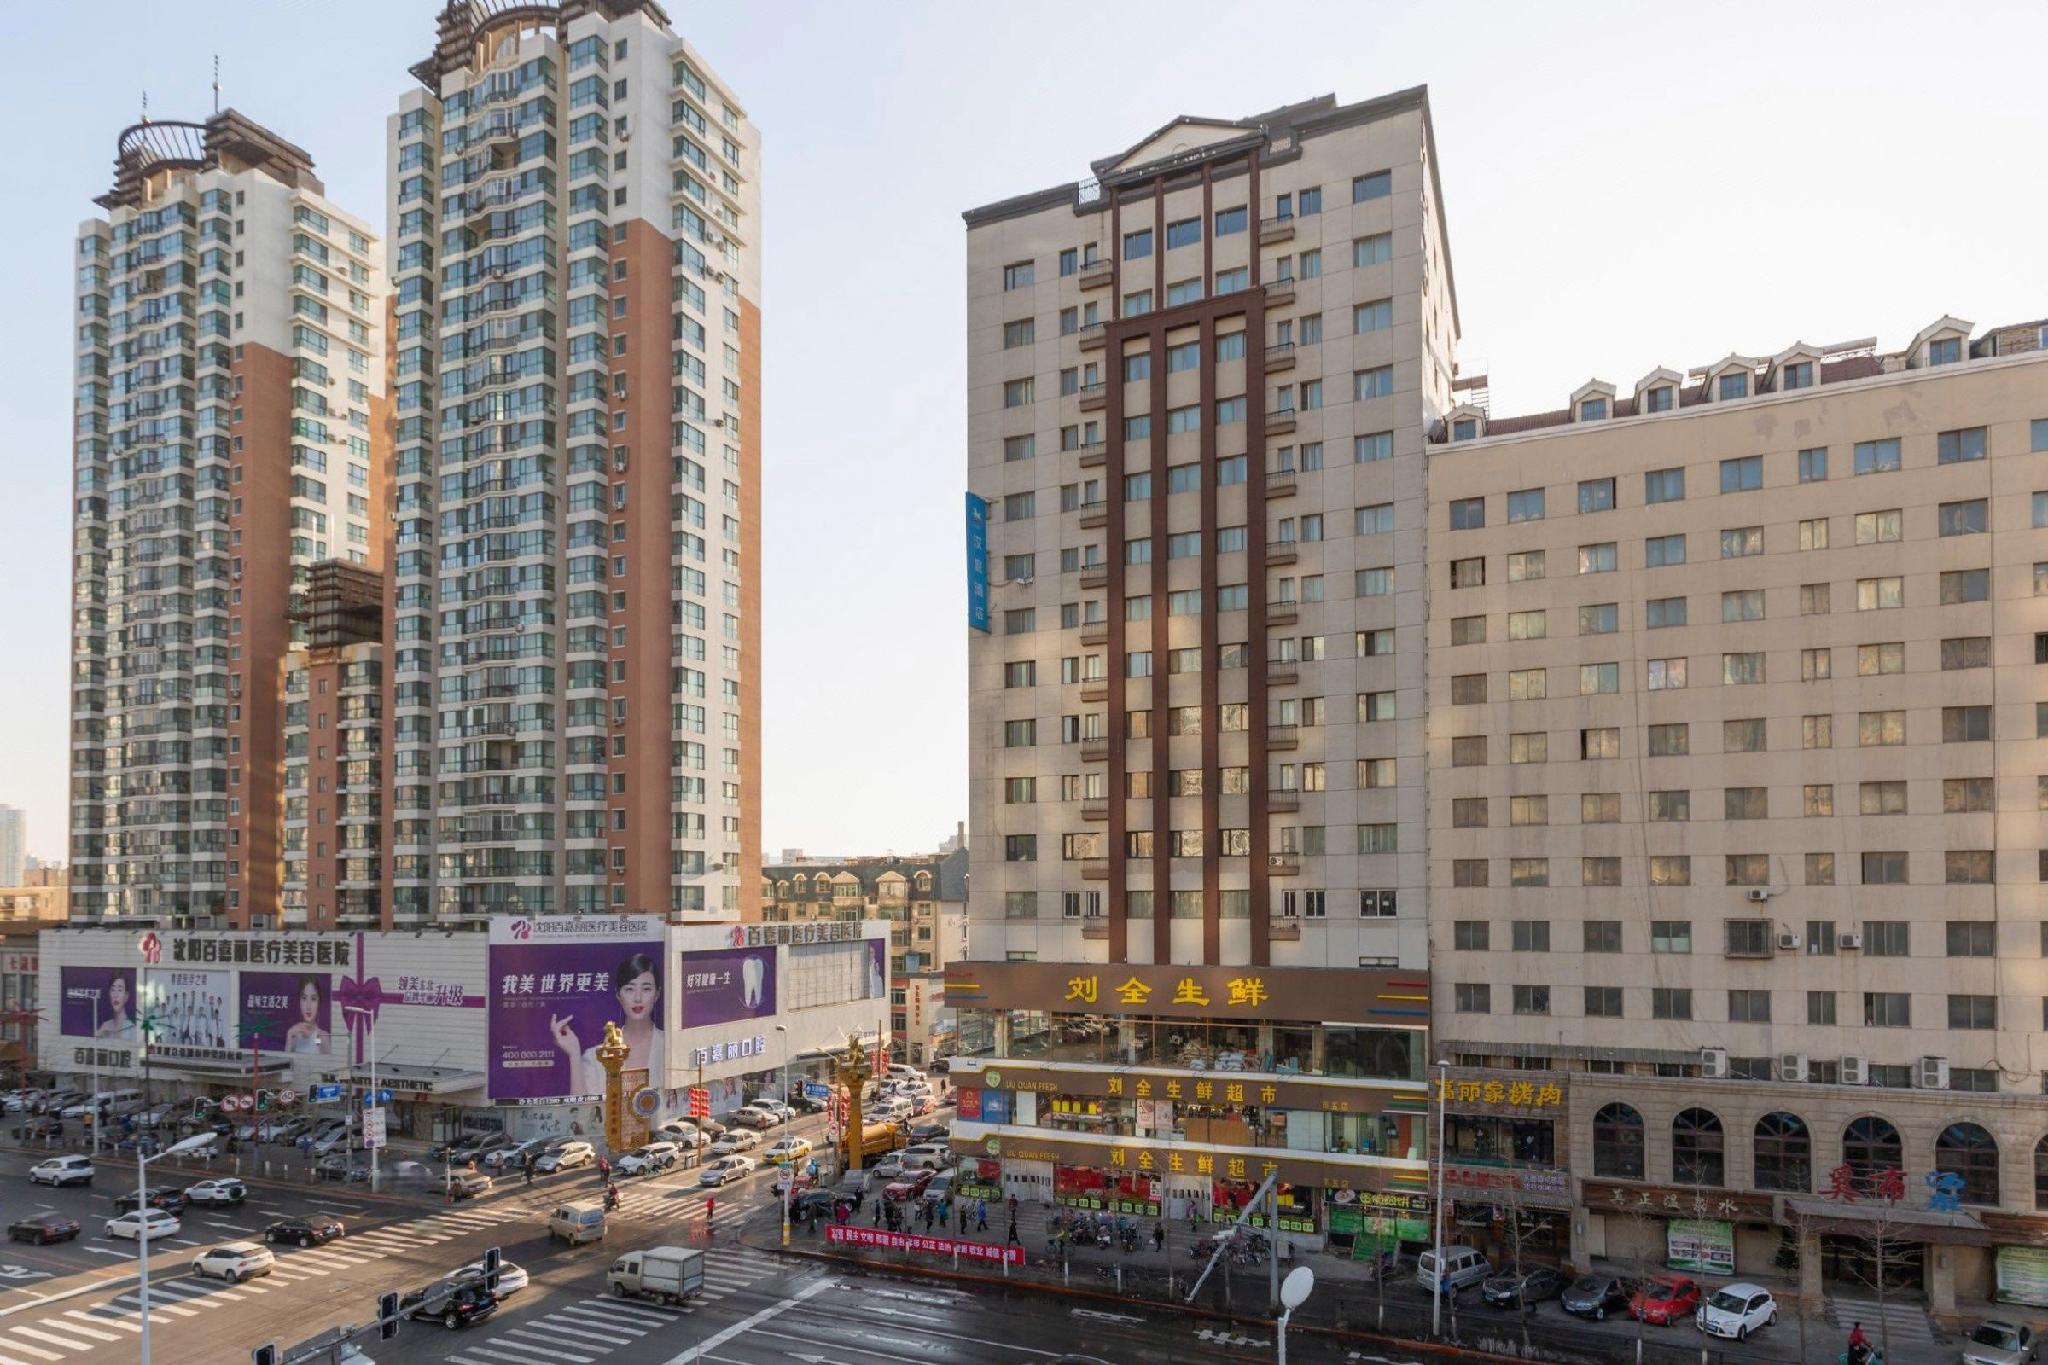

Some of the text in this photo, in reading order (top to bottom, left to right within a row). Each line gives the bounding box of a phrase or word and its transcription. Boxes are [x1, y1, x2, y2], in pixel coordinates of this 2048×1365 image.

[748, 922, 863, 946] 百嘉丽医疗美容医院
[173, 938, 350, 966] 沈阳百嘉丽医疗美容医院
[502, 972, 610, 994] 我美 世界更美
[1065, 975, 1270, 1007] 刘全生鲜
[695, 1034, 767, 1065] 百嘉丽口腔
[381, 1078, 434, 1091] AESTHETIC
[1017, 1081, 1038, 1090] QUAN
[1107, 1076, 1277, 1104] 刘全生鲜超市
[1110, 1148, 1279, 1177] 刘全生鲜超市
